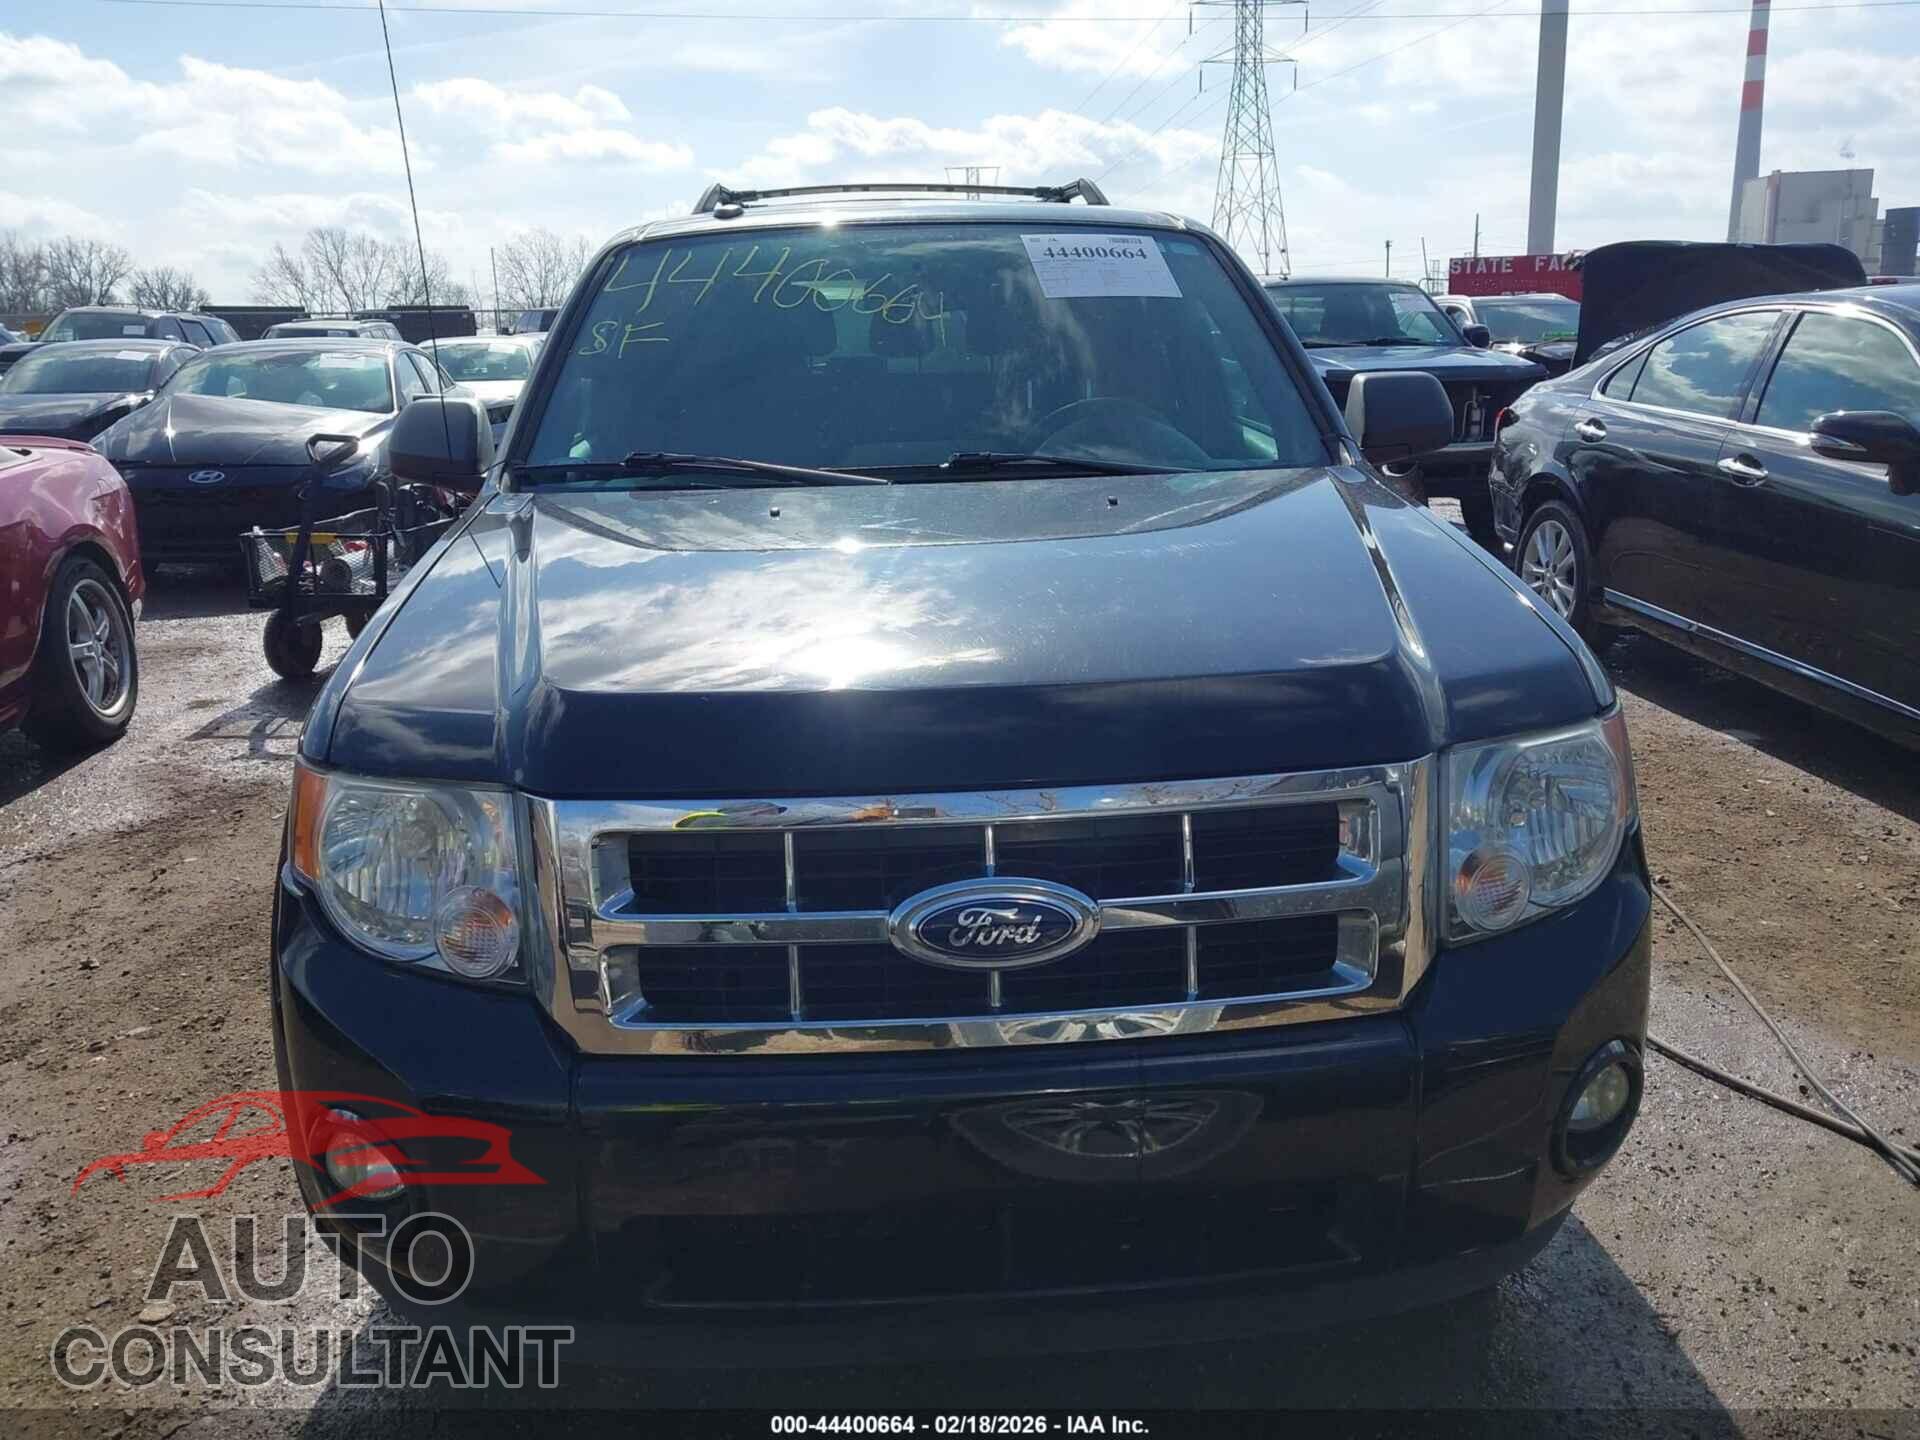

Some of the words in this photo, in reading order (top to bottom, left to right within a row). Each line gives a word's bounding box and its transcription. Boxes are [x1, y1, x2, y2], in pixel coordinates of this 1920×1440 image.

[1043, 246, 1147, 260] 44400664
[1450, 257, 1515, 275] STATE
[603, 245, 947, 348] 44400664
[949, 906, 1043, 947] Ford
